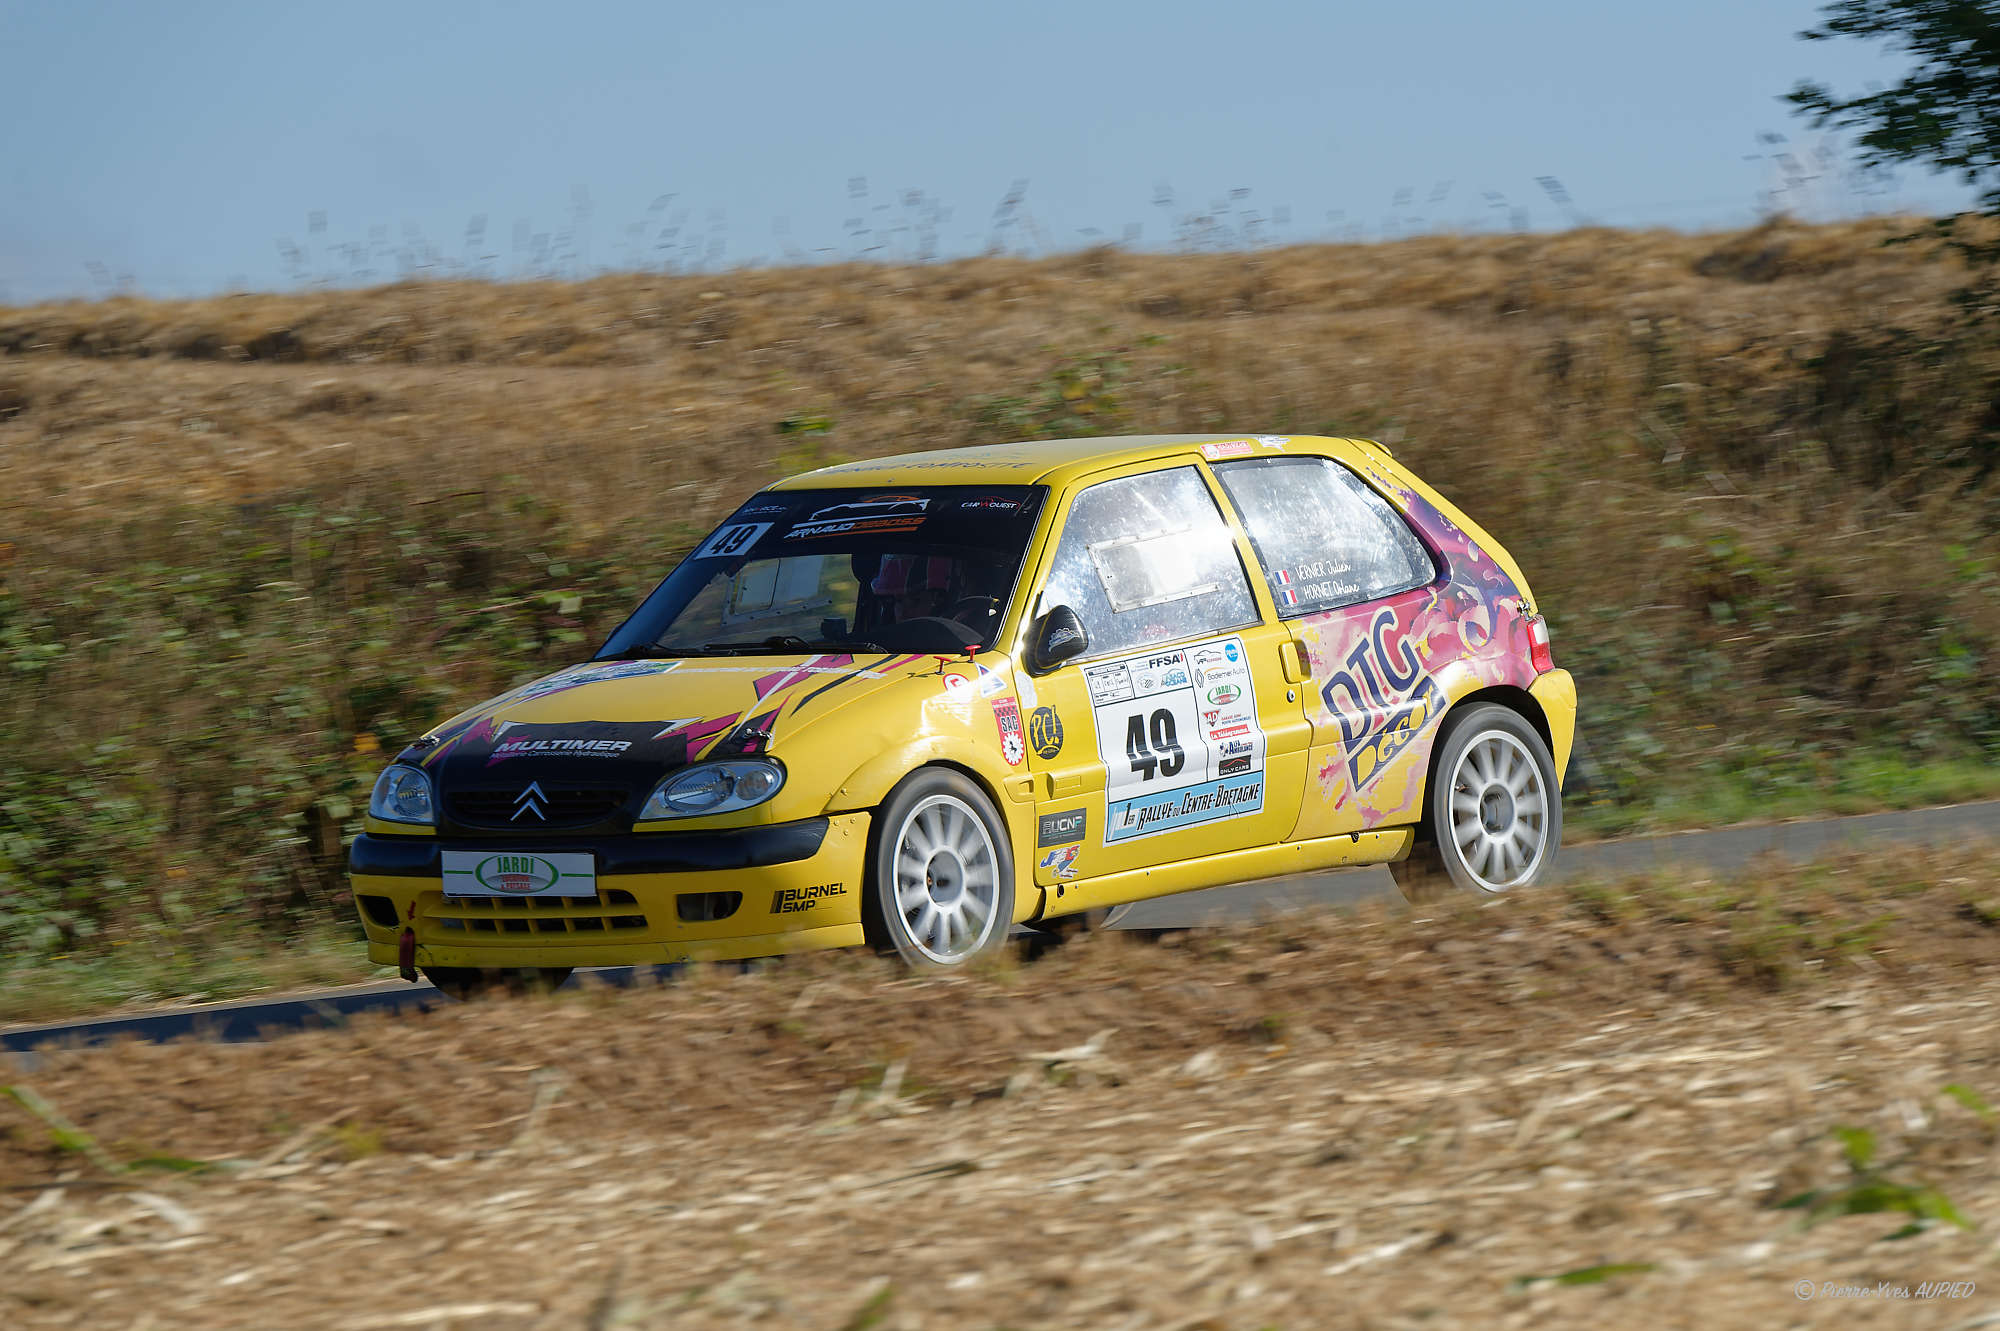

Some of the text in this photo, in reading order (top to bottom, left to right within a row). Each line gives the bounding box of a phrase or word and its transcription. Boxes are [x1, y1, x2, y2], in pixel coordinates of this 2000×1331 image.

[709, 524, 759, 555] 49
[784, 522, 856, 539] ARNAUD
[1303, 580, 1332, 600] HORNET
[1148, 655, 1181, 669] FFSA
[1321, 610, 1421, 755] DTC
[493, 739, 633, 753] MULTIMER
[1126, 708, 1186, 782] 49
[1220, 767, 1235, 775] ONLY
[1136, 802, 1174, 831] RALLYE
[1180, 783, 1261, 815] CENTRE-BRETAGNE
[496, 856, 535, 874] JARDI
[784, 882, 847, 901] BURNEL
[782, 899, 816, 913] SMP
